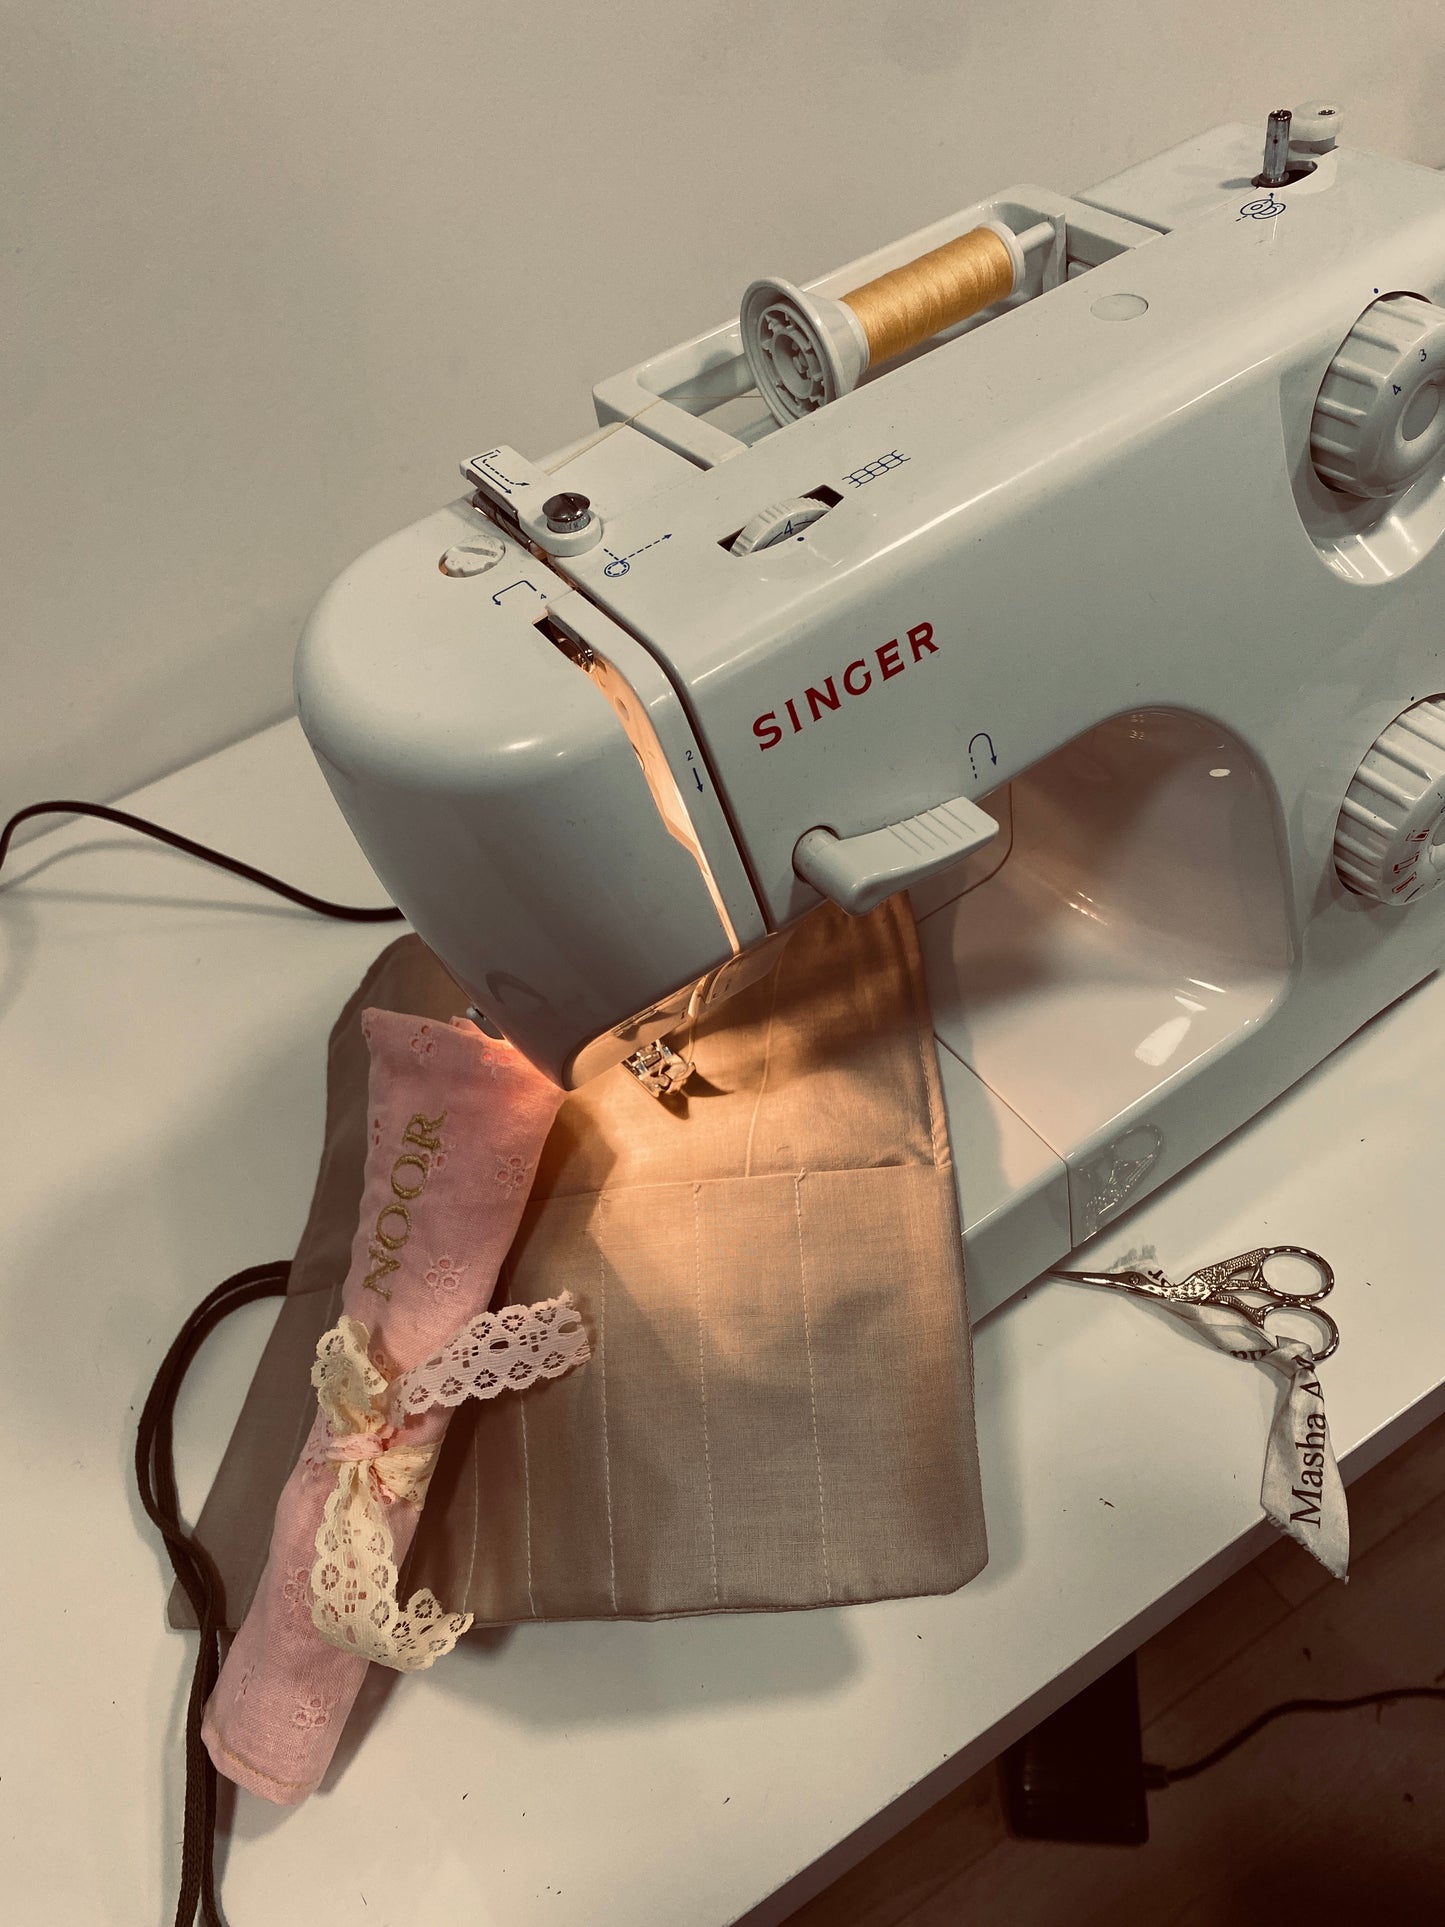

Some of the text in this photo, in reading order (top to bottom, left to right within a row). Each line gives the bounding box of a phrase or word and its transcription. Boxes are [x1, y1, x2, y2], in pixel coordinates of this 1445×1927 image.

[1419, 348, 1428, 362] 3
[1392, 384, 1402, 396] 4
[784, 519, 794, 535] 4
[752, 621, 940, 752] SINGER
[685, 749, 694, 761] 2
[362, 1109, 448, 1303] NOOR
[1289, 1412, 1328, 1529] Masha
